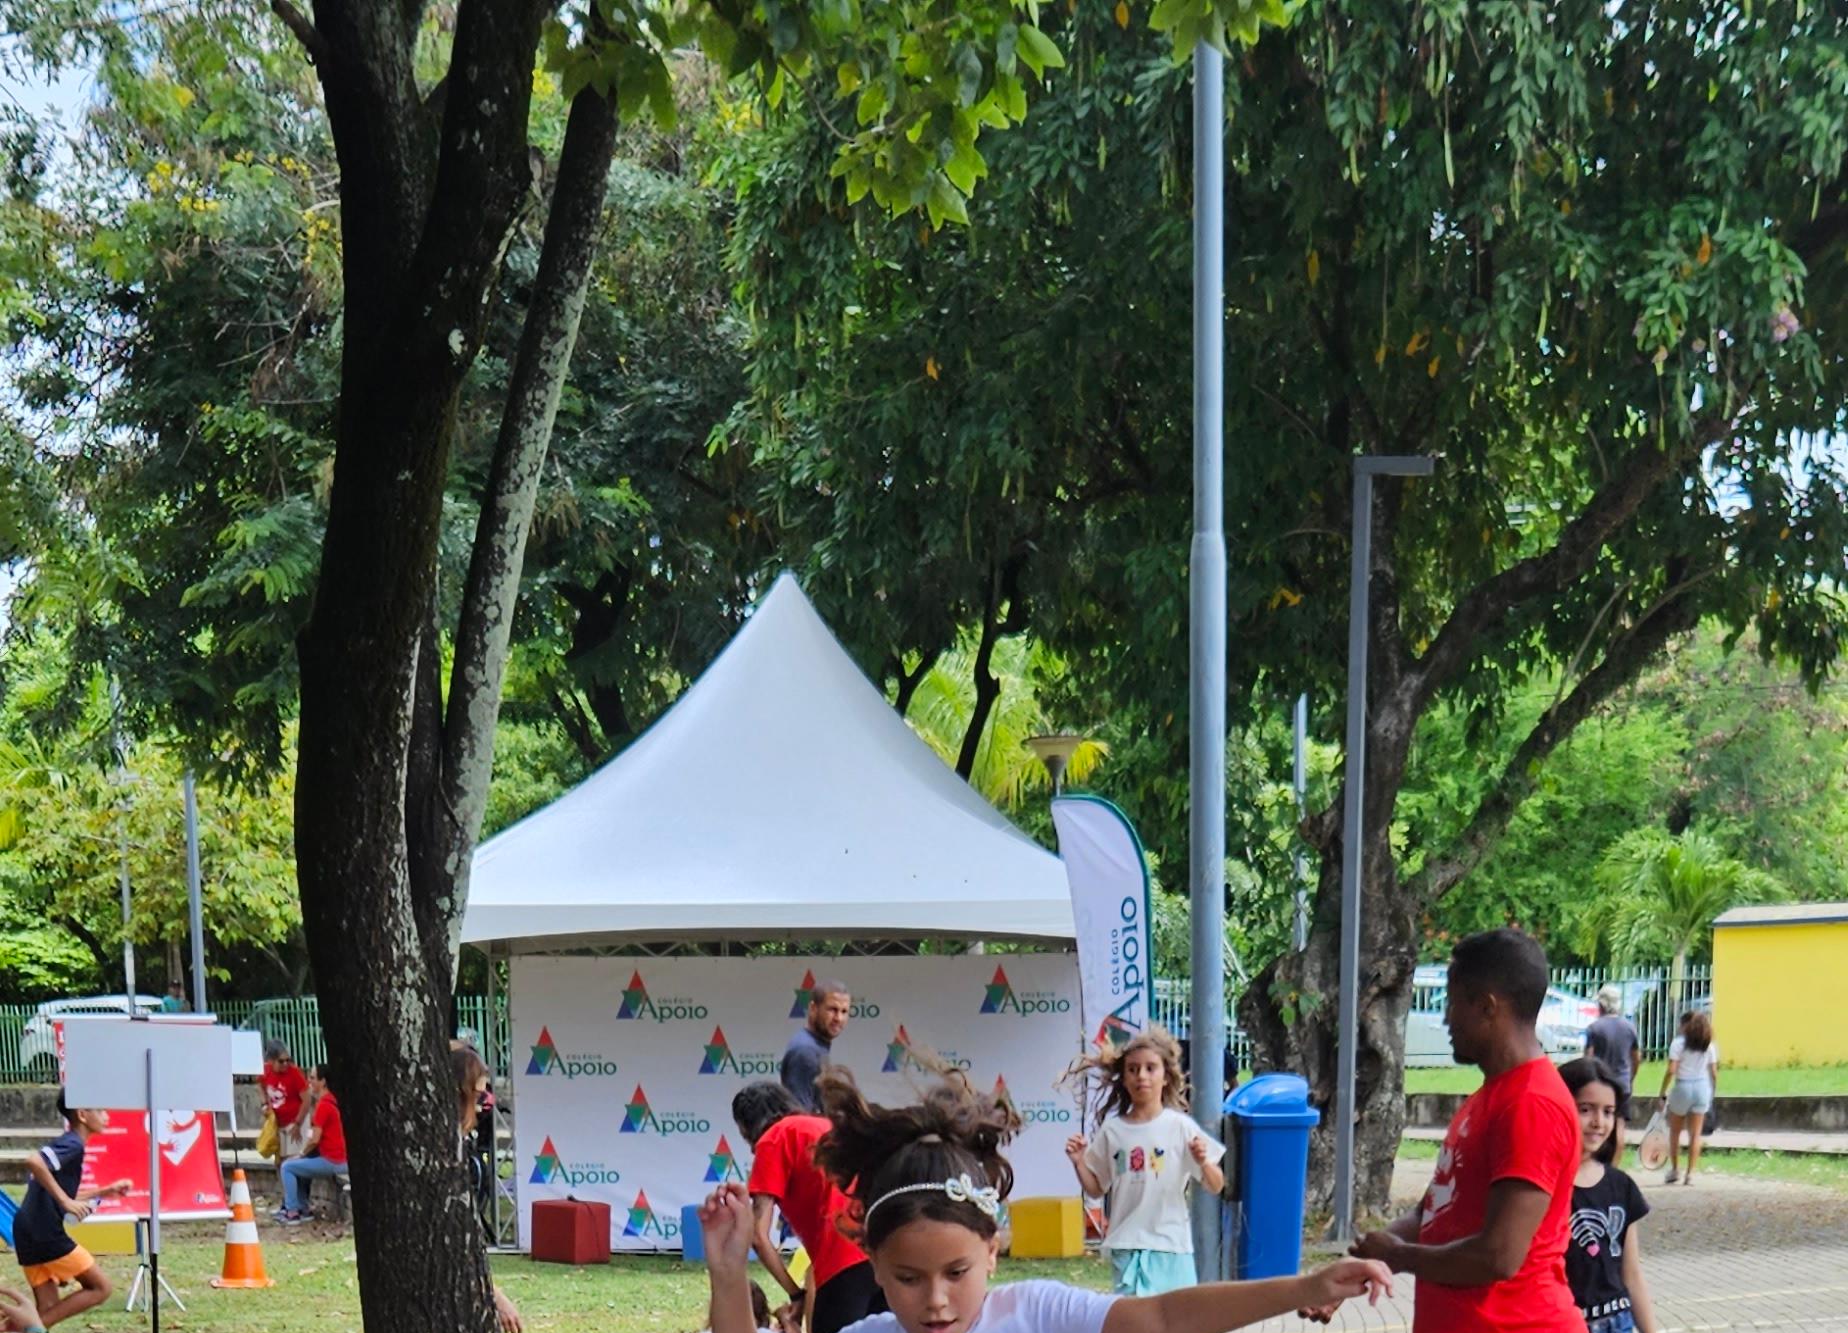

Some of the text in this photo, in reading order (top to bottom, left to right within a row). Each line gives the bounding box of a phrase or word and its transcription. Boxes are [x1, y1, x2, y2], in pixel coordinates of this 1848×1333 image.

[1110, 895, 1144, 1031] Apoio
[637, 995, 708, 1023] Apoio
[1000, 988, 1070, 1017] Apoio
[546, 1051, 617, 1079] Apoio
[640, 1110, 710, 1136] Apoio
[550, 1160, 620, 1188] Apoio
